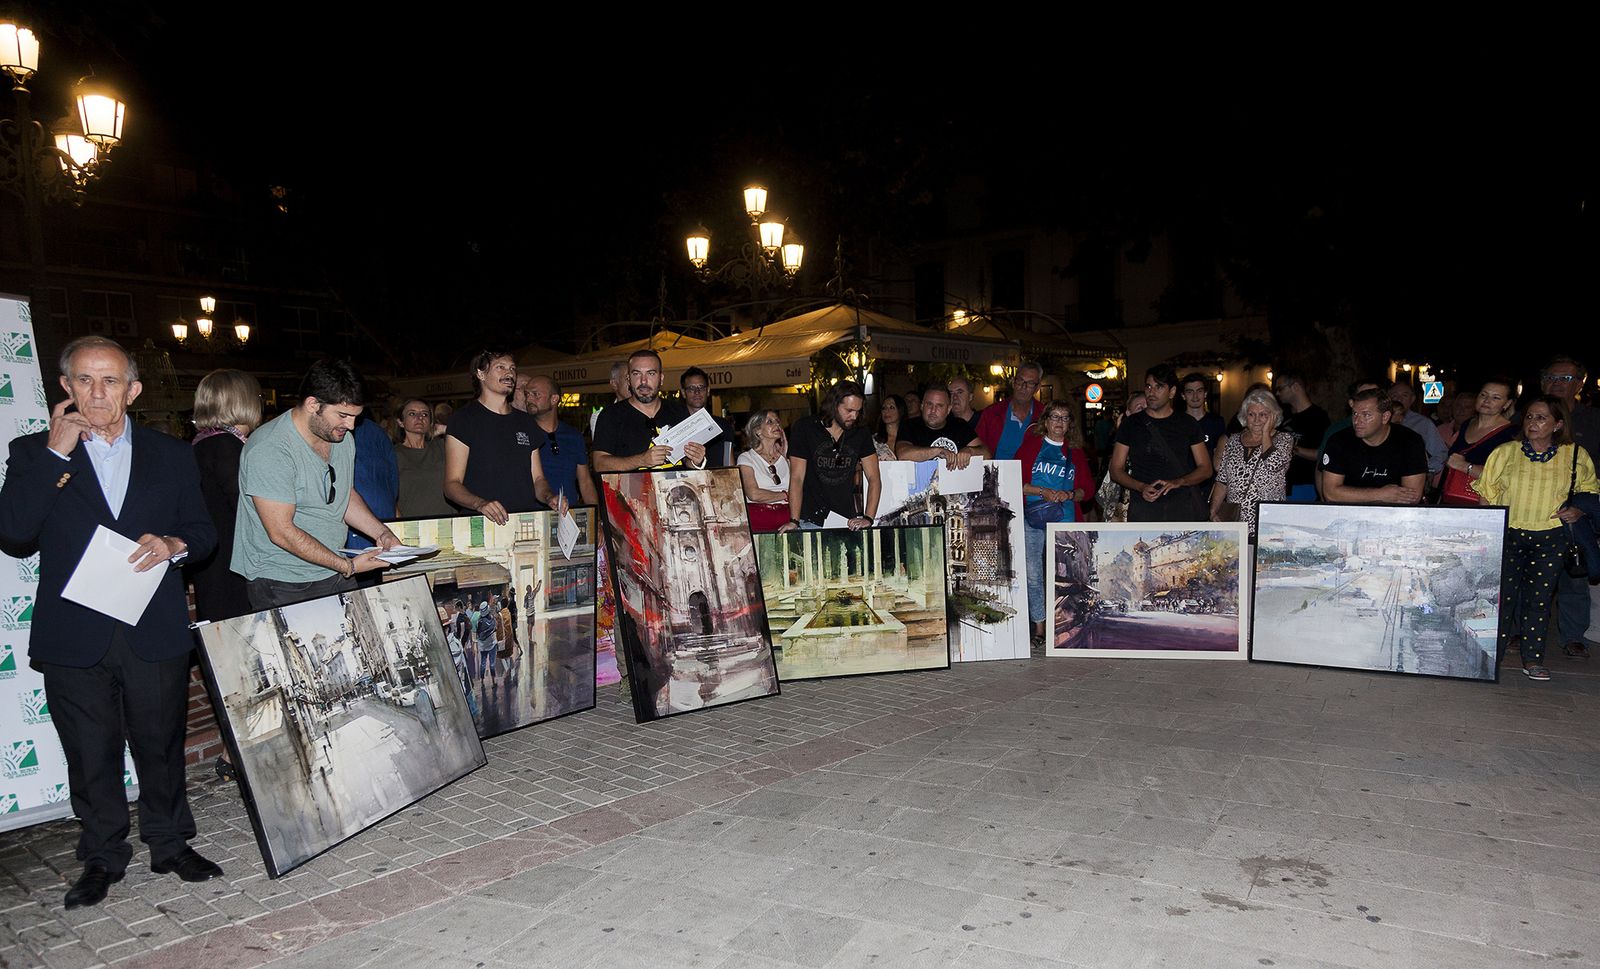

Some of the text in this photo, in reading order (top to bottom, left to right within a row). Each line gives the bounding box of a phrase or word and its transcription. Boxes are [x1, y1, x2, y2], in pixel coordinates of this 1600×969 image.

[931, 346, 970, 361] CHIKITO
[553, 367, 588, 381] CHIKITO
[707, 368, 801, 385] KITO Café
[426, 381, 453, 393] CHIKITO
[1032, 462, 1057, 475] EAM
